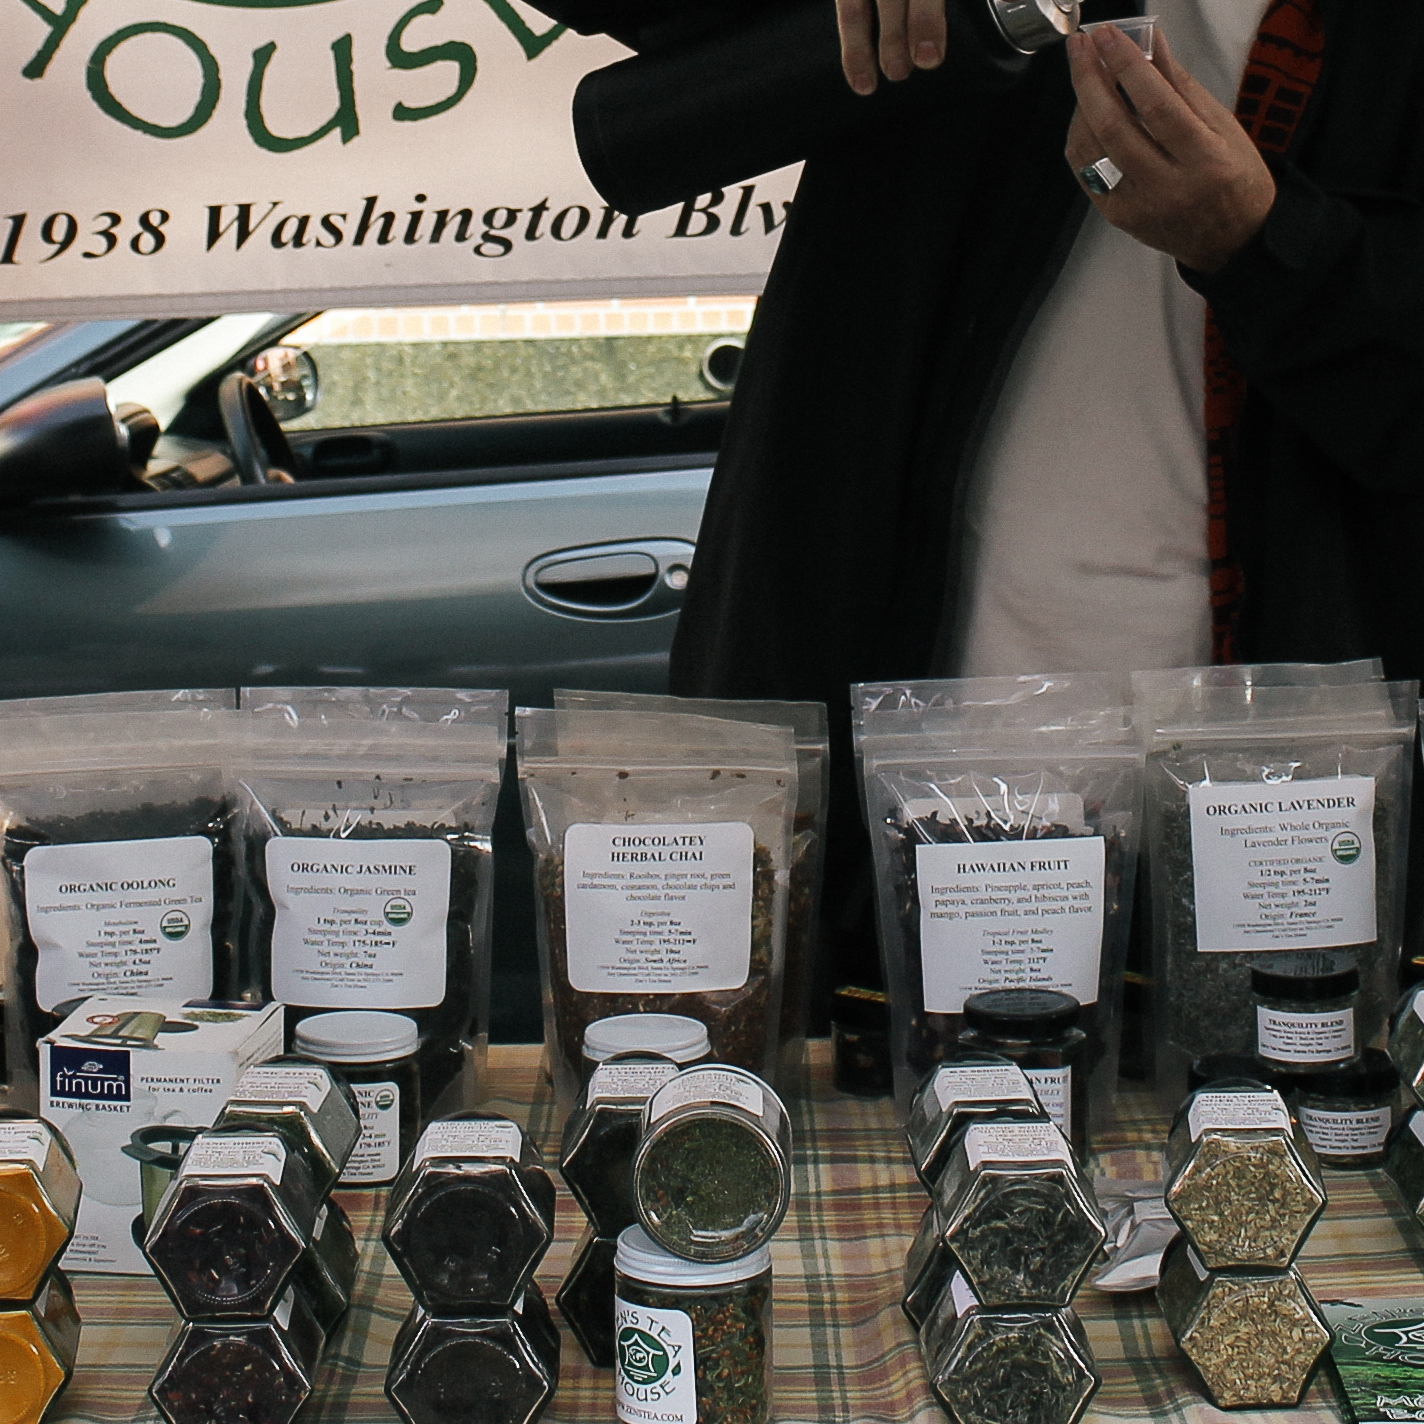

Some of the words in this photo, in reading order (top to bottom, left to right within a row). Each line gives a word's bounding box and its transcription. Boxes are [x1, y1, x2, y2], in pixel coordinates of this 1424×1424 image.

[204, 192, 641, 259] Washington
[671, 186, 793, 240] Blv
[1205, 801, 1273, 816] ORGANIC
[1278, 796, 1355, 812] LAVENDER
[611, 835, 706, 846] CHOCOLATEY
[1244, 837, 1287, 848] Lavender
[1291, 835, 1328, 846] Flowers
[611, 851, 666, 862] HERBAL
[669, 850, 702, 861] CHAI
[290, 862, 353, 874] ORGANIC
[356, 864, 416, 875] JASMINE
[957, 861, 1025, 873] HAWAIIAN
[1030, 859, 1069, 871] FRUIT
[58, 881, 117, 893] ORGANIC
[120, 878, 175, 890] OOLONG
[56, 1066, 126, 1095] finum
[49, 1100, 91, 1112] BREWING
[94, 1103, 130, 1112] BASKET
[646, 1316, 682, 1359] TEA
